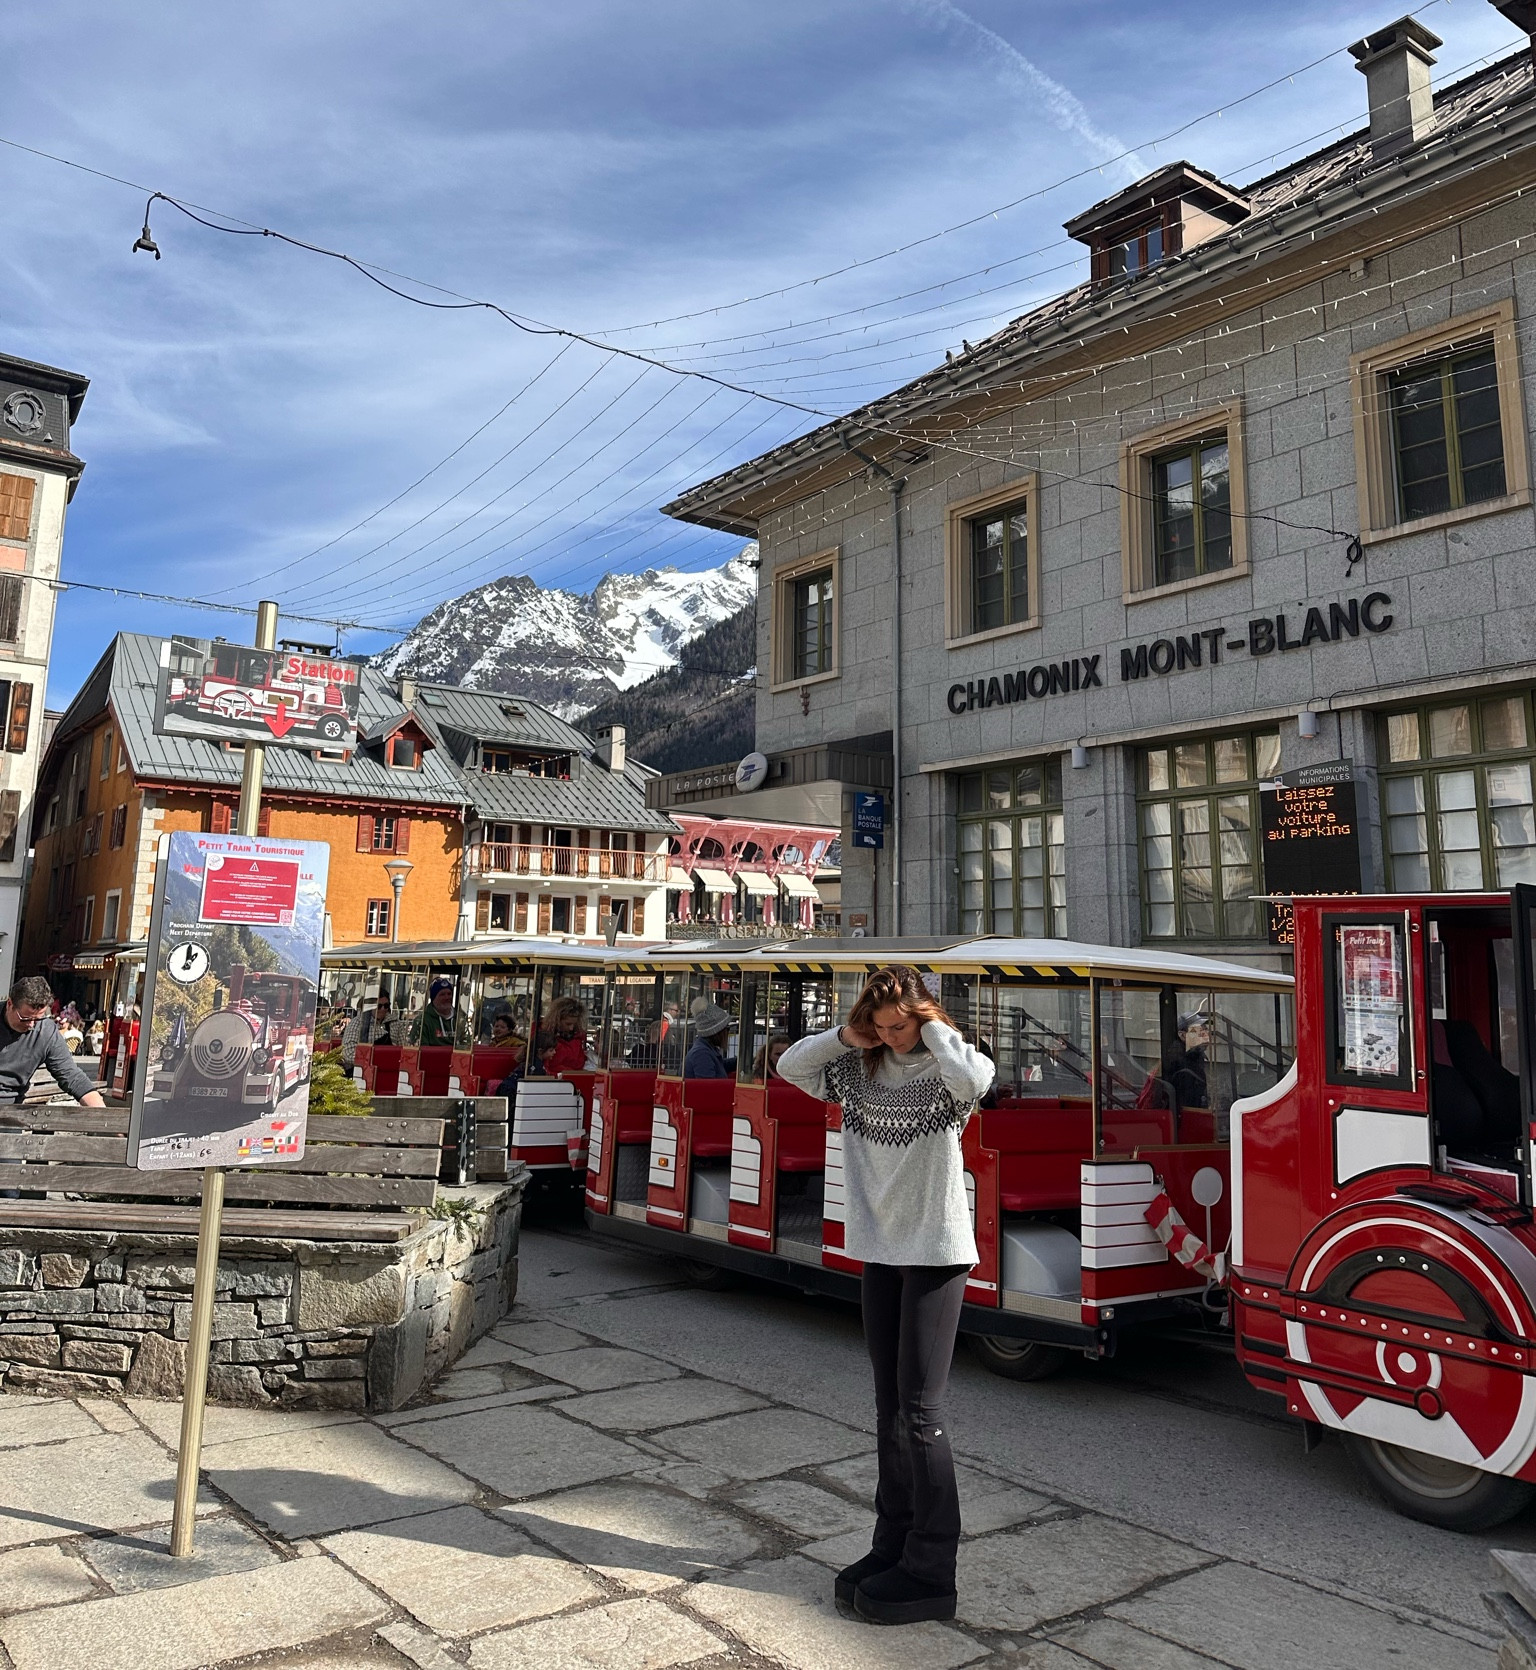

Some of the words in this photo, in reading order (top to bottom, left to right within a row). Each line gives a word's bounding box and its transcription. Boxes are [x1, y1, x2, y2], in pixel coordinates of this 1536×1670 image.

[947, 653, 1102, 715] CHAMONIX
[1120, 591, 1394, 682] MONT-BLANC
[287, 657, 355, 684] Station
[1298, 764, 1350, 777] INFORMATIONS
[676, 779, 690, 792] LA
[696, 773, 735, 787] POSTE
[1299, 772, 1351, 785] MUNICIPALES
[1276, 786, 1335, 802] Laissez
[857, 807, 866, 815] LA
[1284, 799, 1328, 813] votre
[857, 814, 882, 823] BANQUE
[857, 821, 882, 830] POSTALE
[1278, 812, 1337, 827] voiture
[1267, 829, 1286, 841] au
[1290, 823, 1351, 840] parking
[719, 925, 751, 939] ROSE
[1349, 936, 1366, 945] Petit
